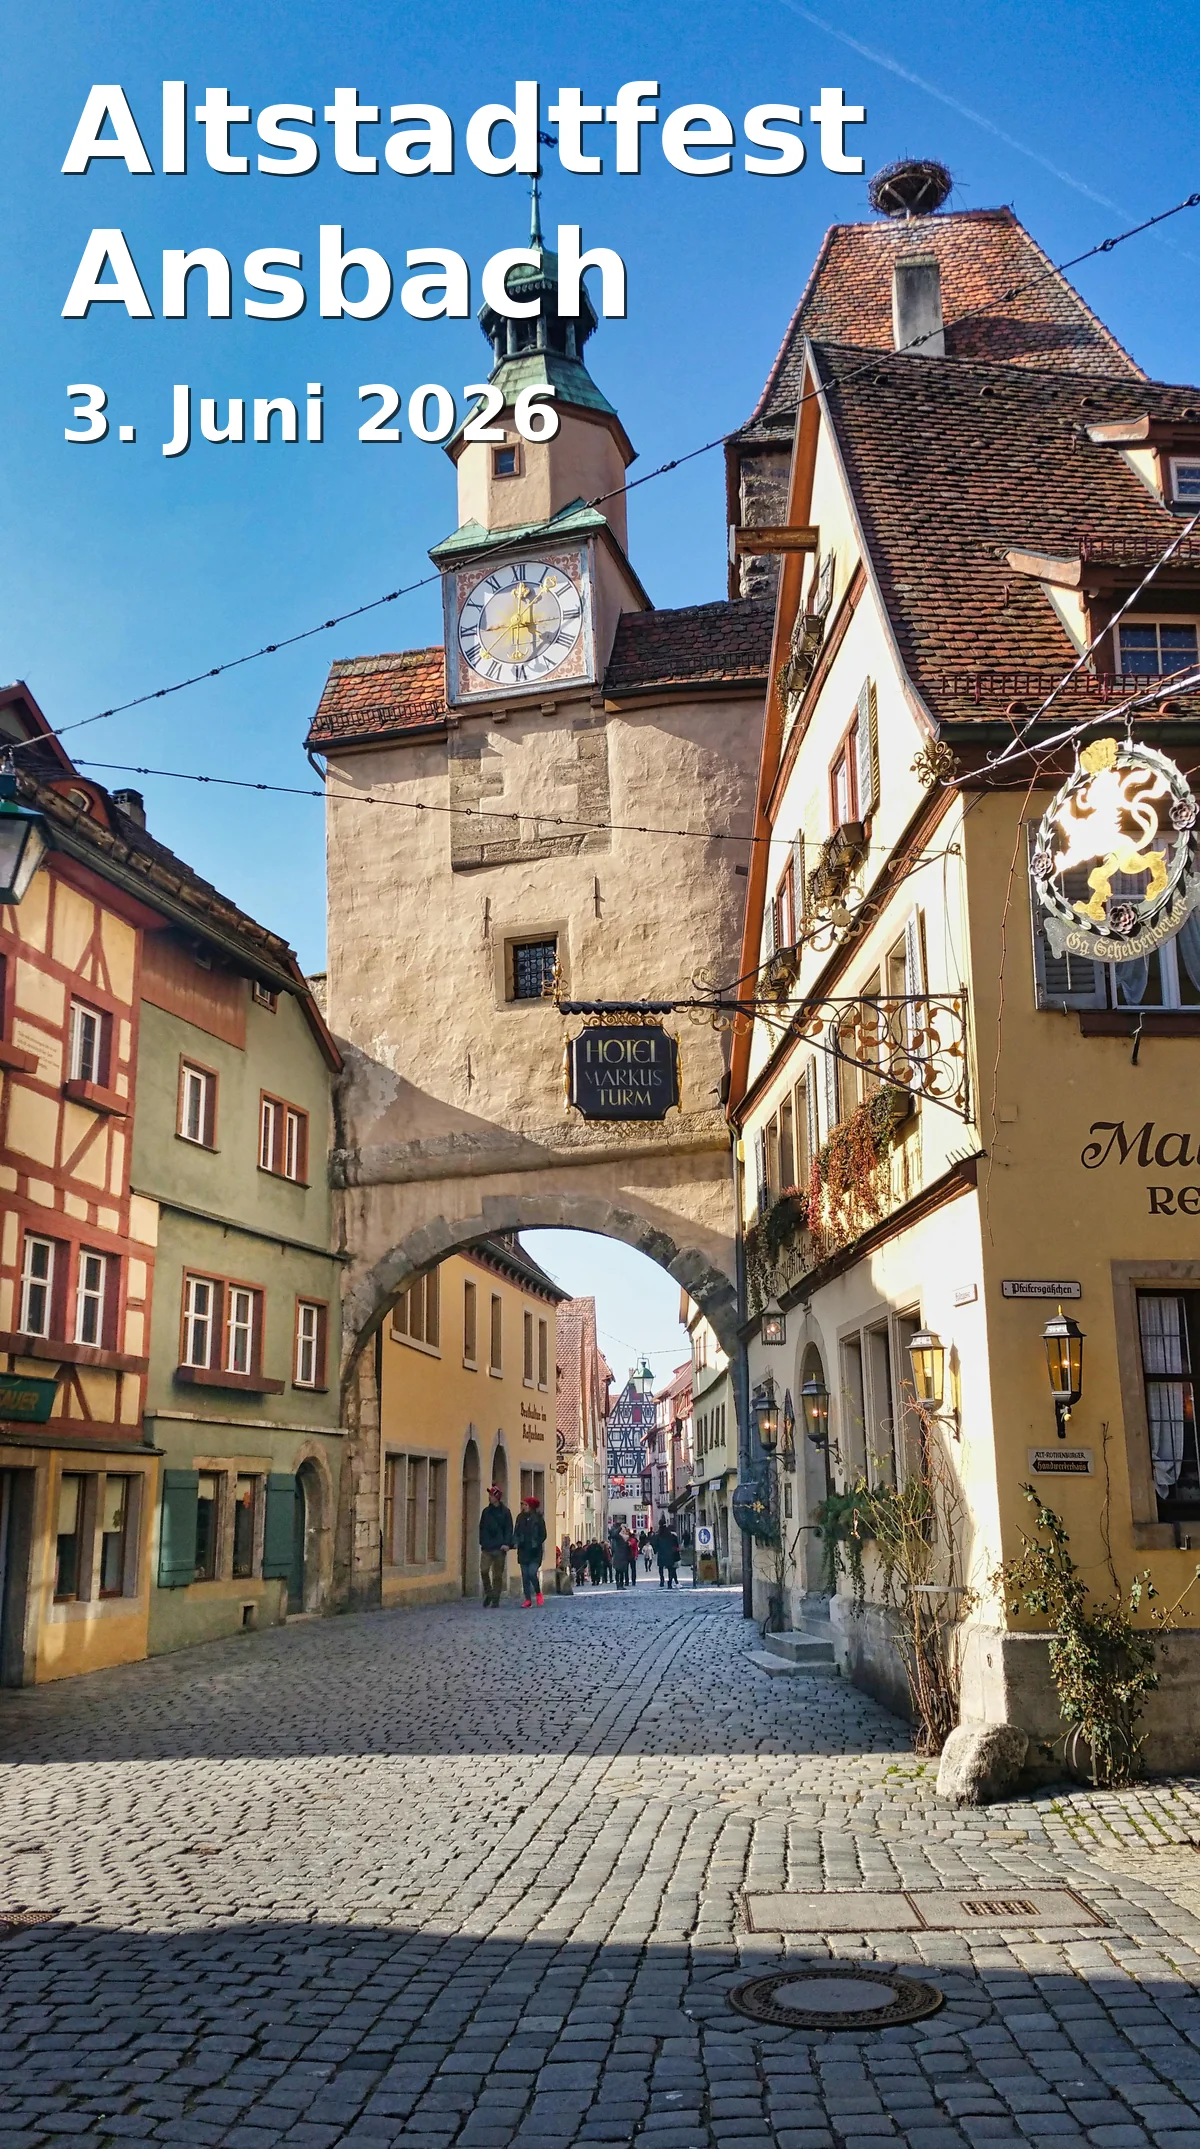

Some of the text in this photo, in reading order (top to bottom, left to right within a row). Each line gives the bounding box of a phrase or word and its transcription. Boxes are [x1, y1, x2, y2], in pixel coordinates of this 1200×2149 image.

[586, 1039, 661, 1064] HOTEL
[584, 1068, 664, 1087] MARKUS
[597, 1088, 652, 1106] TURM
[1081, 1120, 1200, 1169] Ma
[1146, 1186, 1200, 1216] RE
